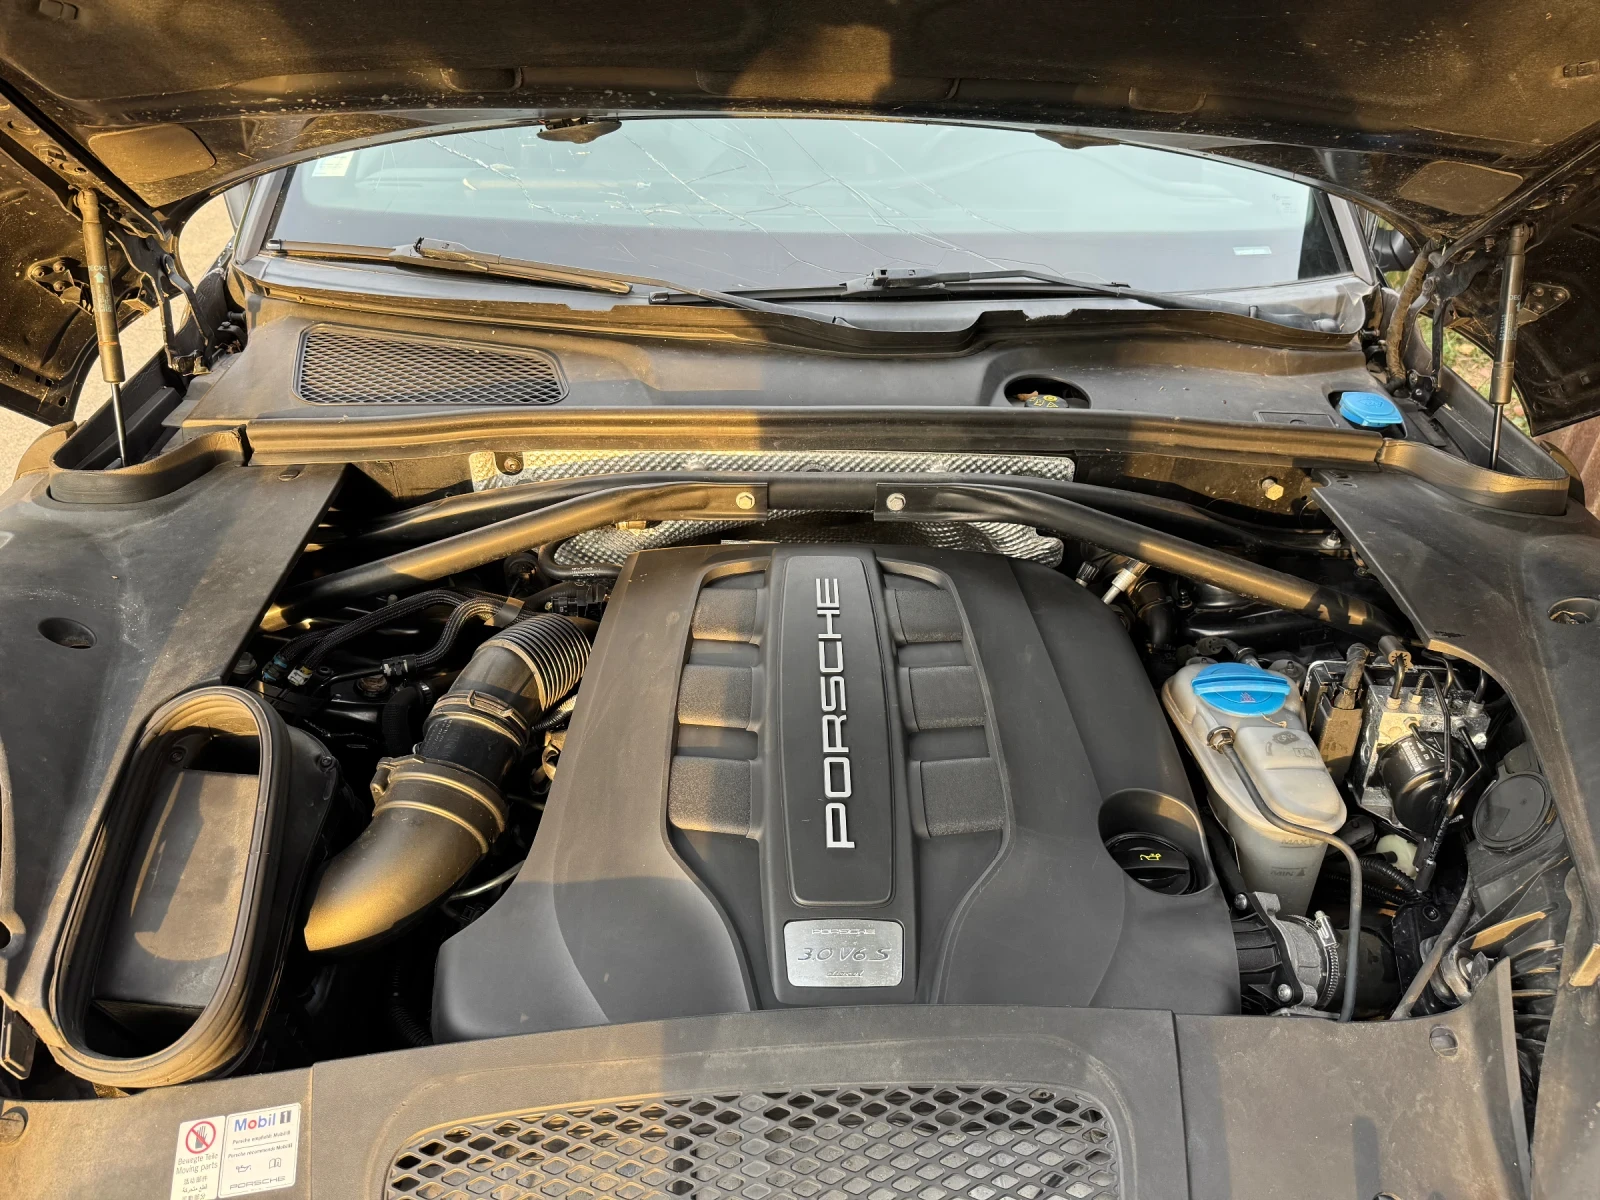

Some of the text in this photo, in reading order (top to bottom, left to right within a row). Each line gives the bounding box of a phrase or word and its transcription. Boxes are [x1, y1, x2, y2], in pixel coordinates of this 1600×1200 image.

[815, 578, 855, 849] PORSCHE
[797, 947, 893, 961] 3.0 V6 S
[233, 1110, 292, 1132] Mobil 1
[176, 1161, 218, 1174] Moving parts
[177, 1156, 204, 1165] Bewegte
[229, 1175, 286, 1191] PORSCHE
